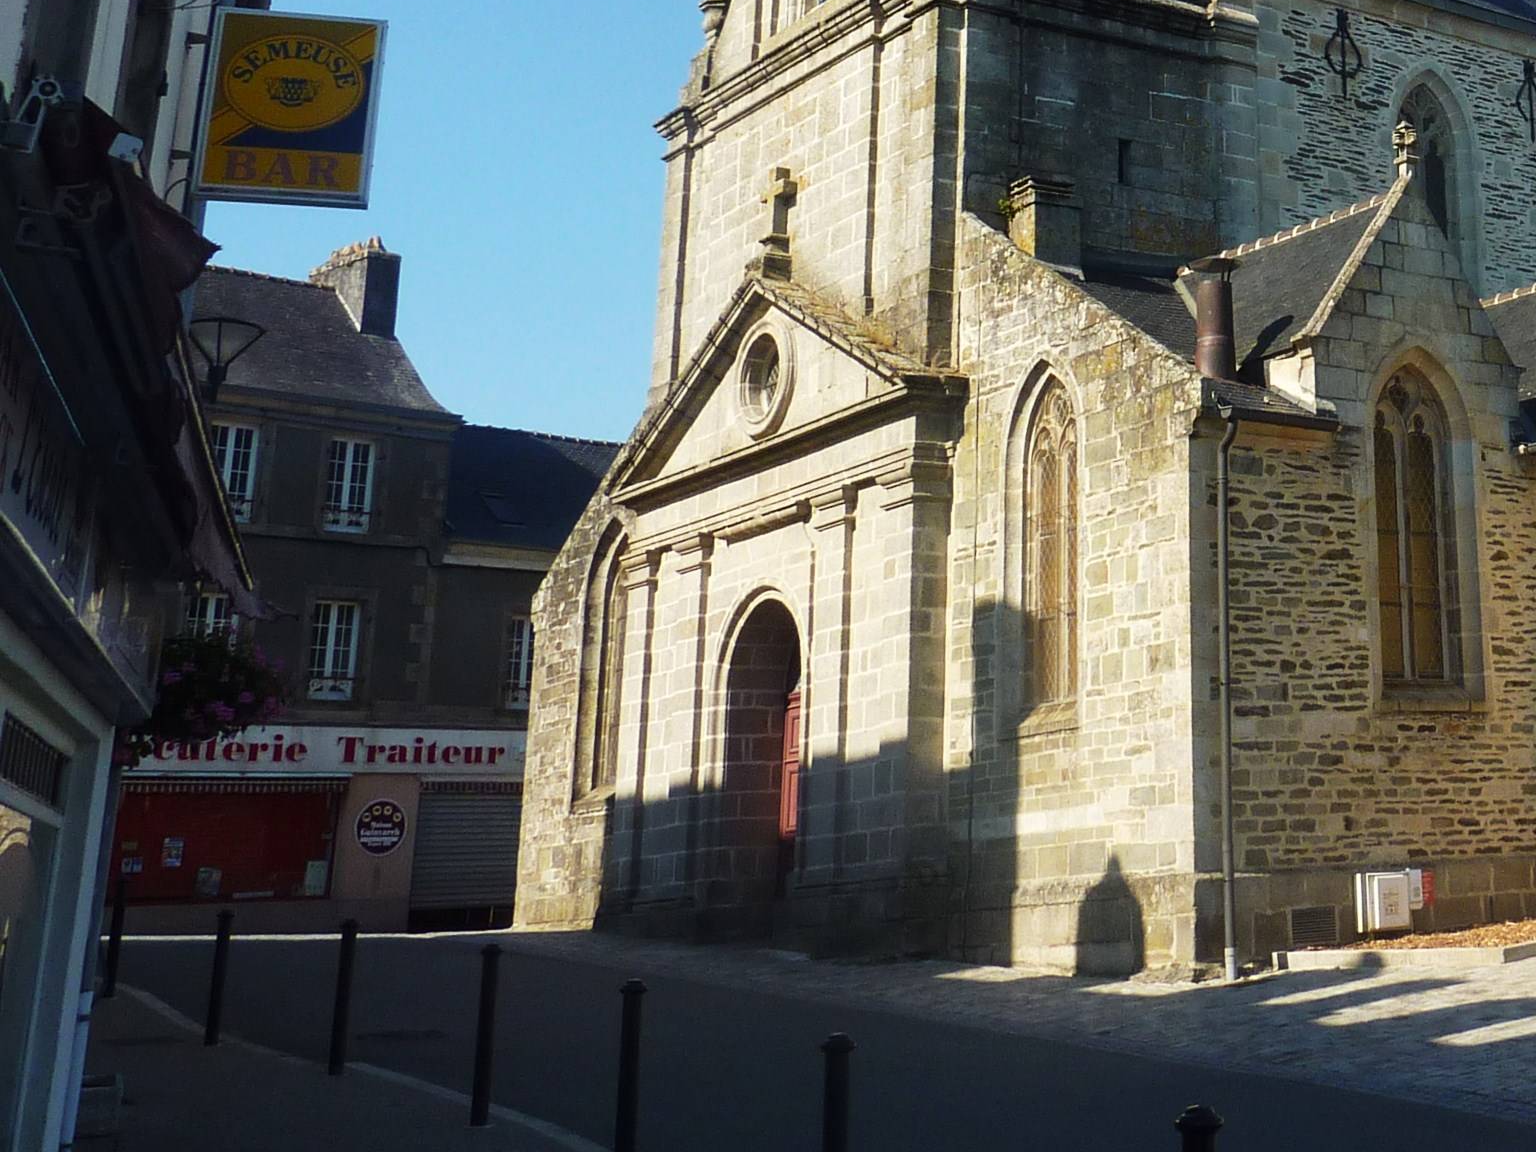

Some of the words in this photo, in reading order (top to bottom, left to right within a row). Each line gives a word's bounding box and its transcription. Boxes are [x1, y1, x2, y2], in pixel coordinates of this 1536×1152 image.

[233, 41, 357, 89] SEMEUSE
[226, 150, 338, 185] BAR
[153, 734, 308, 762] cuterie
[337, 736, 505, 764] Traiteur
